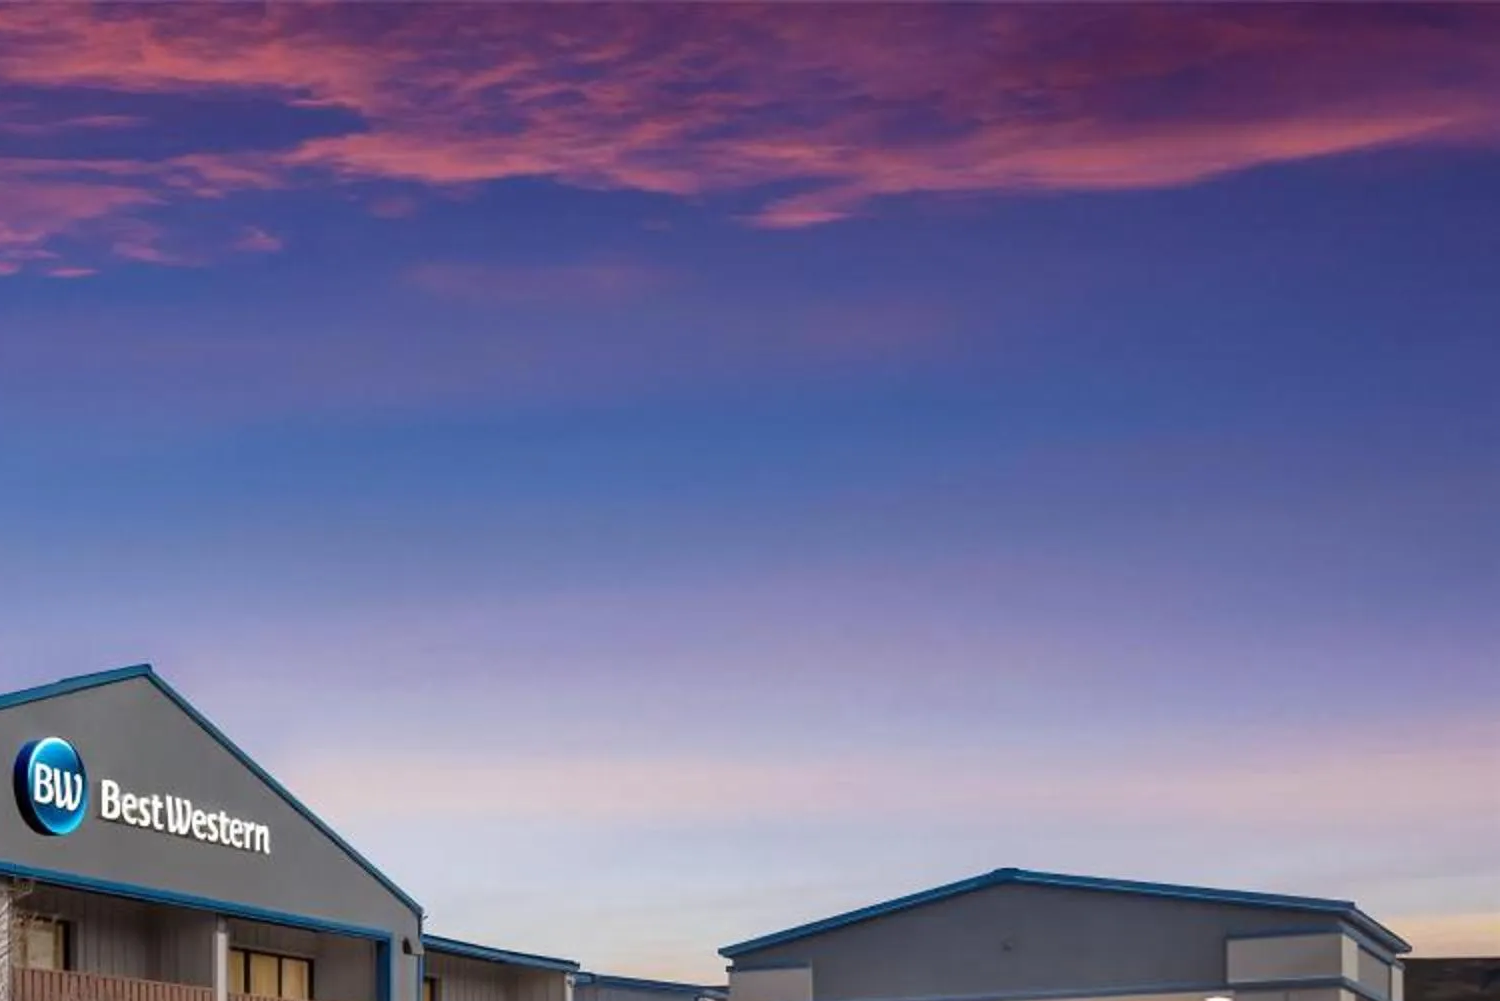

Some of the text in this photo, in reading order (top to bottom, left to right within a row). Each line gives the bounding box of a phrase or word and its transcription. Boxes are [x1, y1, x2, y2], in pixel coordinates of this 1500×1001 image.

[33, 763, 82, 811] BW
[100, 779, 271, 854] Best Western
